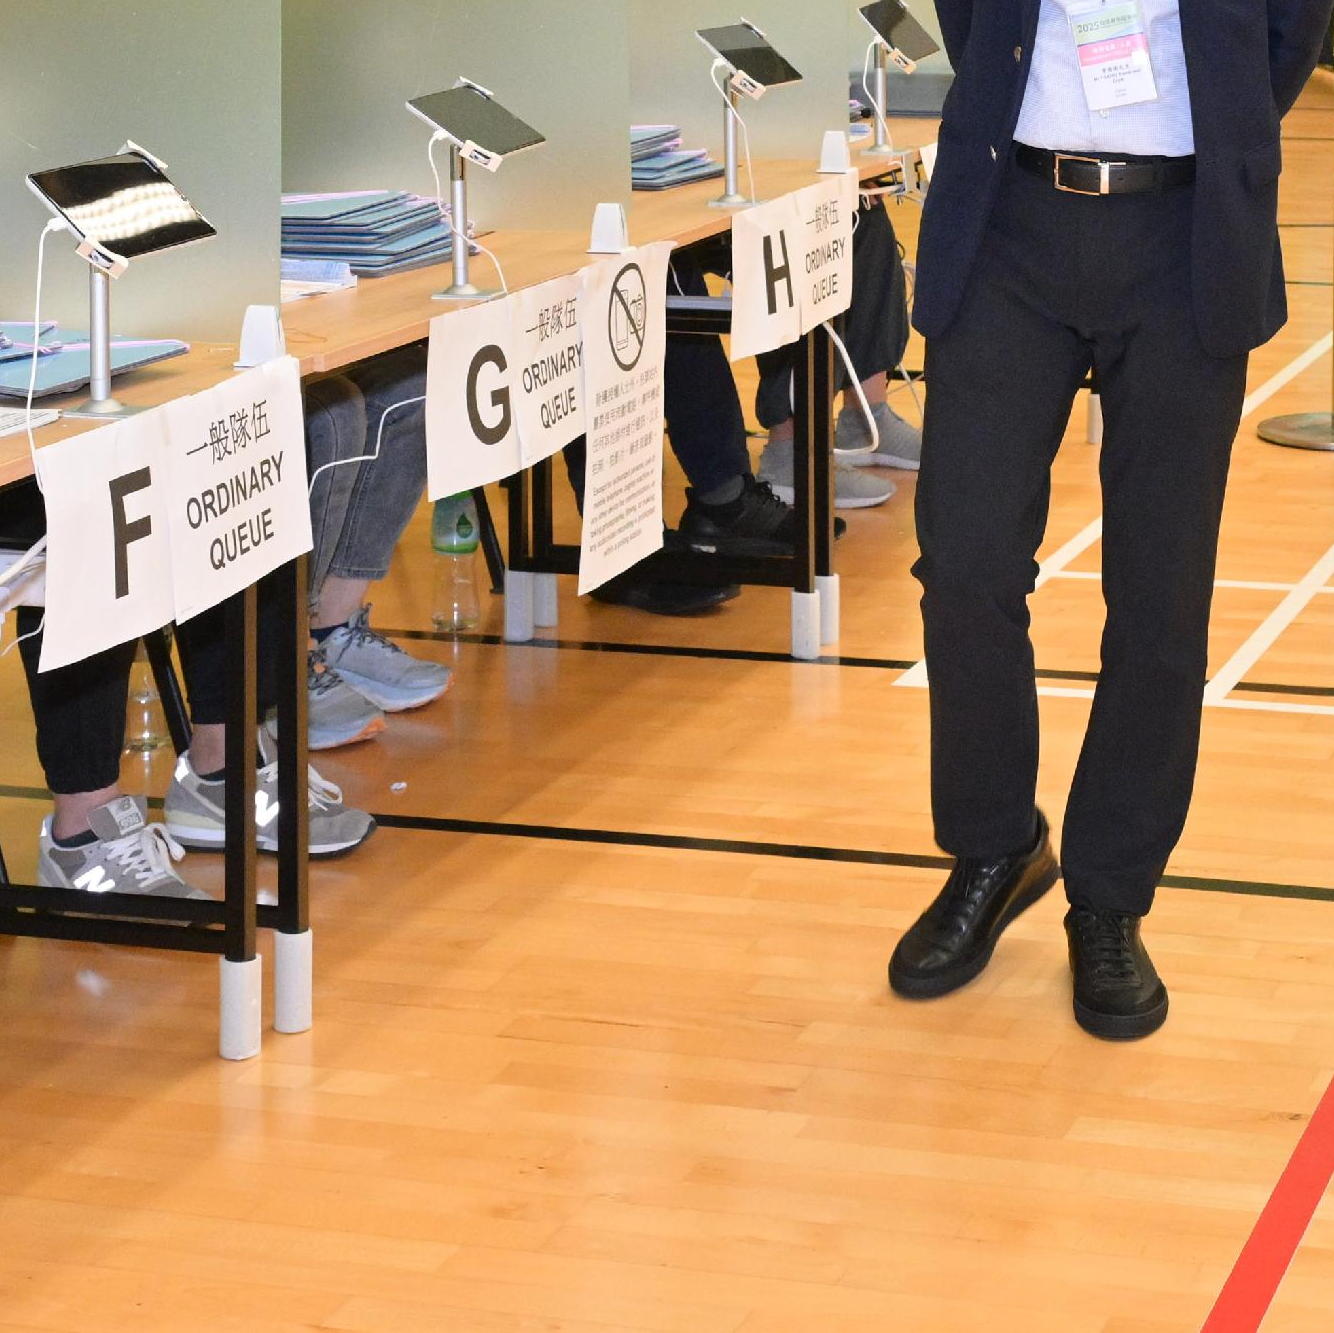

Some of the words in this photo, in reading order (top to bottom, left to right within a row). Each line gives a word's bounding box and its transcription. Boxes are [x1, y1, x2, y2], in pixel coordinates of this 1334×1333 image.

[763, 229, 794, 315] H
[805, 236, 846, 274] ORDINARY
[525, 297, 577, 342] 一般隊伍
[812, 273, 838, 305] QUEUE
[466, 343, 512, 446] G
[522, 340, 583, 394] ORDINARY
[186, 399, 271, 465] 一般隊伍
[540, 387, 577, 429] QUEUE
[186, 450, 284, 530] ORDINARY
[109, 466, 153, 599] F
[209, 508, 275, 570] QUEUE
